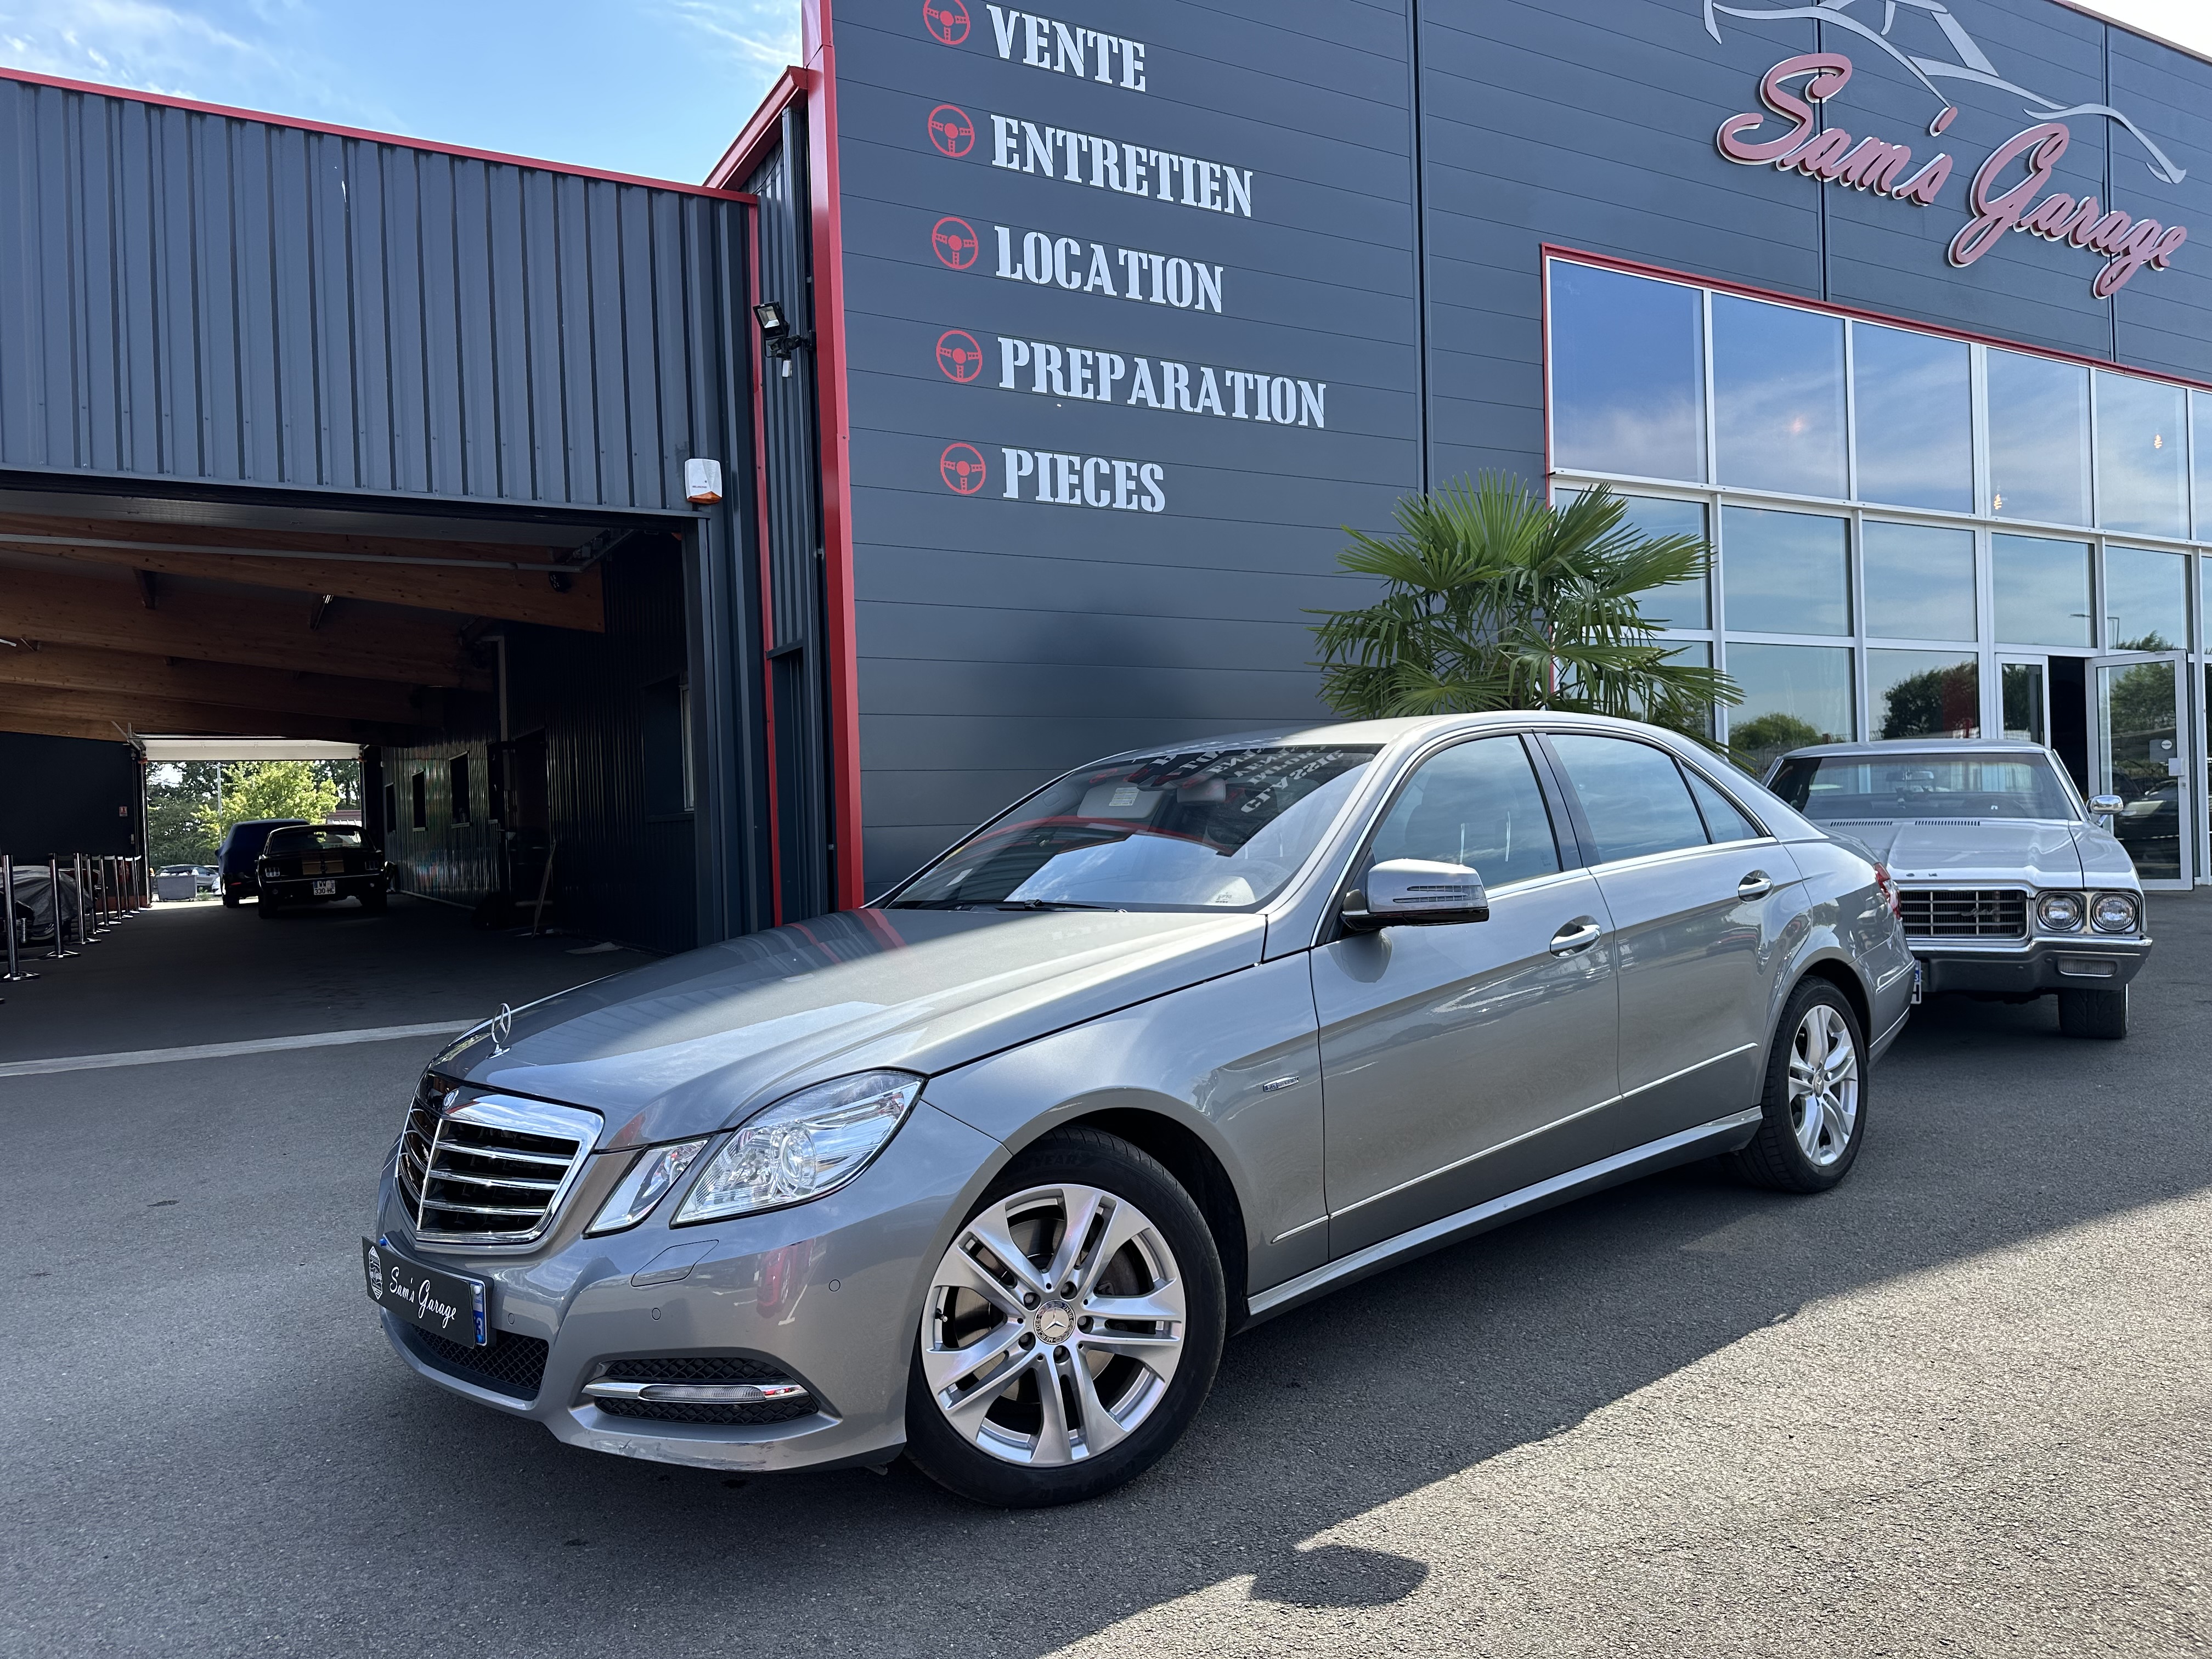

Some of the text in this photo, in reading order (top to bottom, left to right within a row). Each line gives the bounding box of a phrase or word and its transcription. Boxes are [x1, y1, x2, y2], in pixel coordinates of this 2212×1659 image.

[987, 5, 1146, 92] VENTE
[990, 114, 1253, 217] ENTRETIEN
[1717, 53, 2187, 299] Sam's Garage
[994, 225, 1223, 313] LOCATION
[997, 337, 1327, 428] PREPARATION
[1001, 447, 1166, 513] PIECES
[390, 1266, 456, 1328] Sam's Garage
[1036, 1318, 1053, 1342] MERCEDES
